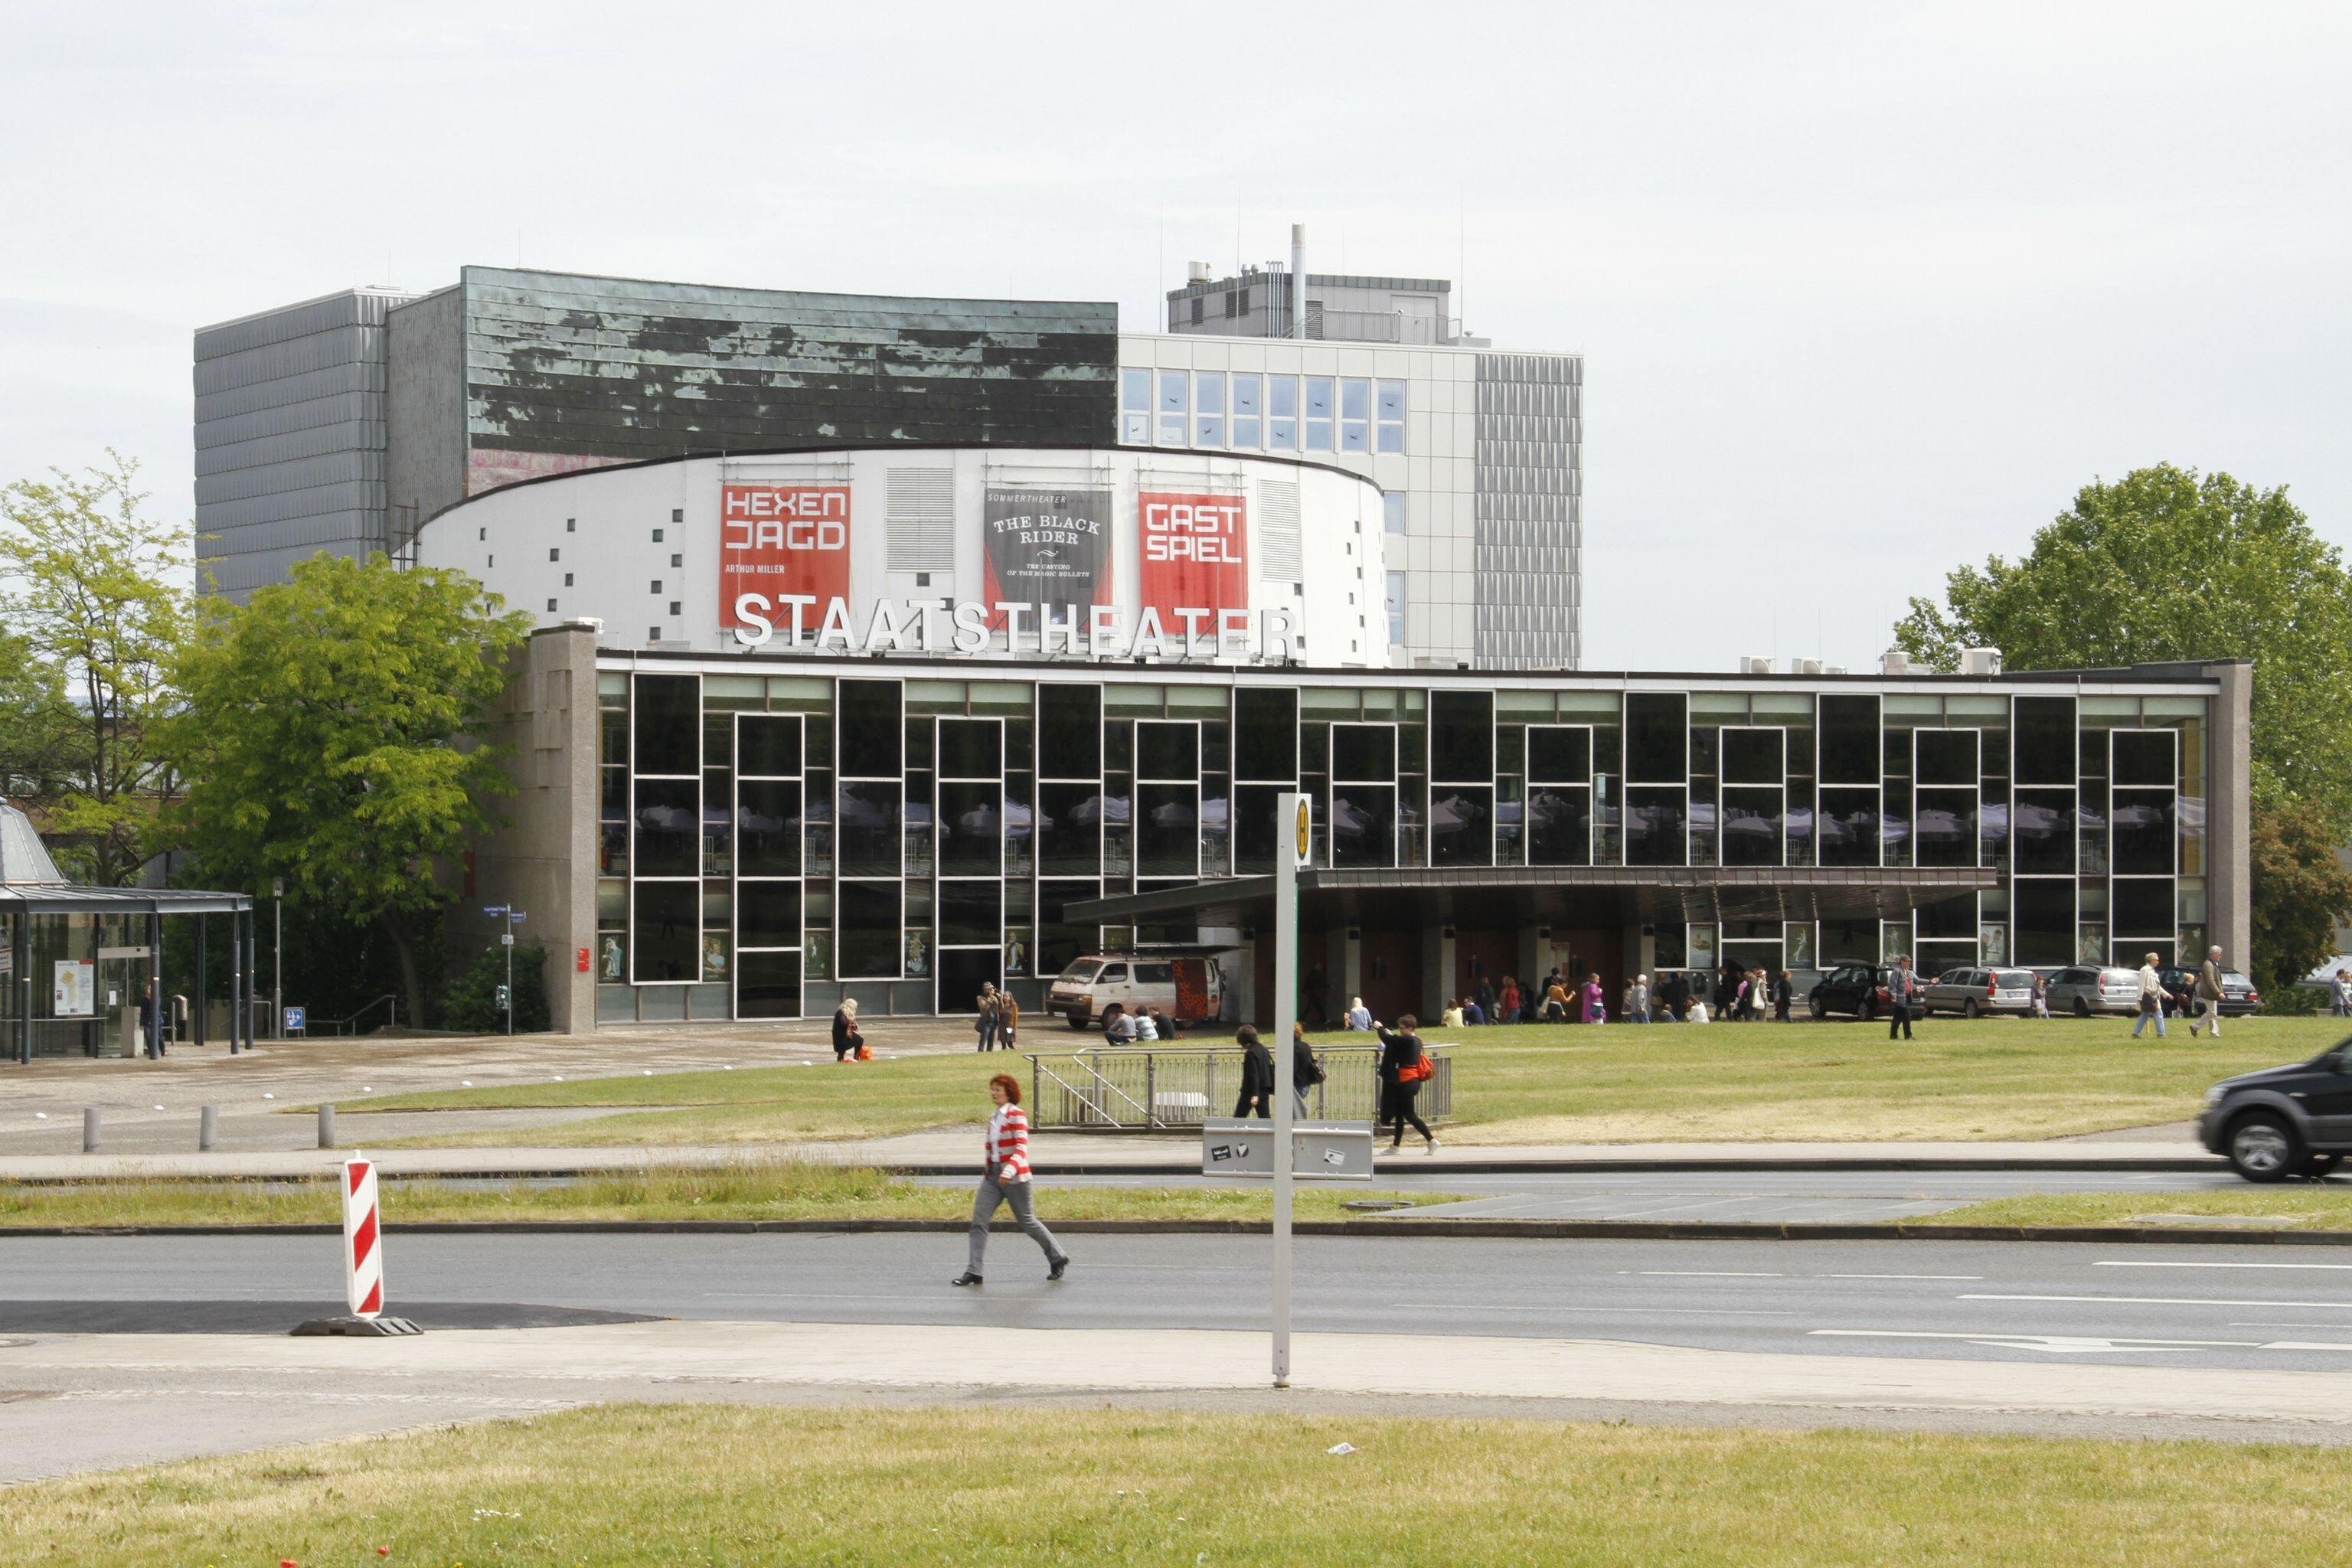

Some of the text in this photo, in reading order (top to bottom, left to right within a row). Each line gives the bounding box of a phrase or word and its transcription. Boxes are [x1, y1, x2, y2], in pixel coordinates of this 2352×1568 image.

[727, 492, 846, 516] HEXEN
[988, 494, 1067, 503] SOMMERTHEATER
[994, 515, 1100, 535] THE BLACK
[1146, 503, 1242, 534] GAST
[726, 521, 845, 550] JAGD
[1020, 531, 1079, 545] RIDER
[1147, 534, 1242, 564] SPIEL
[725, 564, 785, 574] ARTHUR MILLER
[733, 593, 1297, 660] STAATSTHEATER
